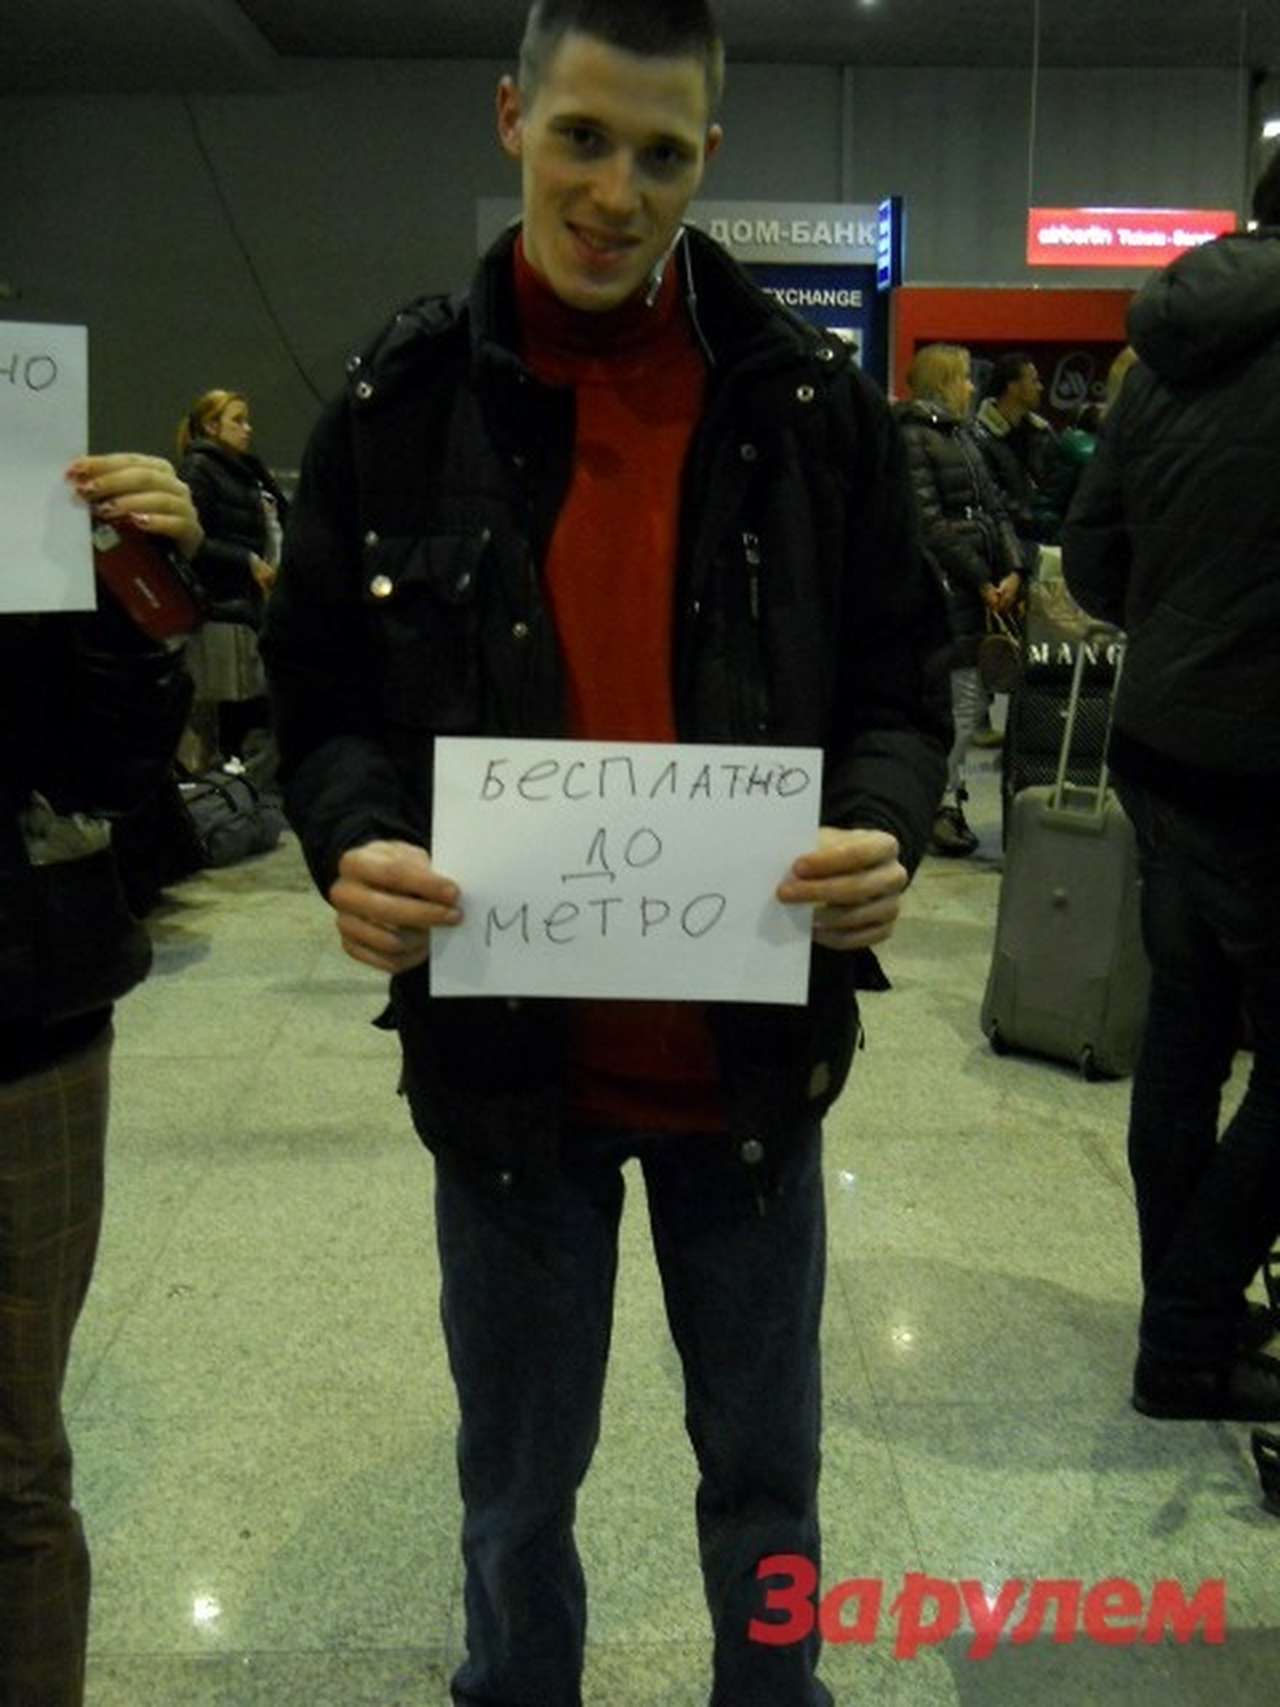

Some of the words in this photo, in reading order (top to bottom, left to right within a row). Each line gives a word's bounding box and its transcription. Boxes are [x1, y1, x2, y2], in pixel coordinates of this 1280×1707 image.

[710, 218, 876, 248] ДОМ-БАНК
[762, 287, 863, 308] XCHANGE
[560, 827, 663, 884] ДО
